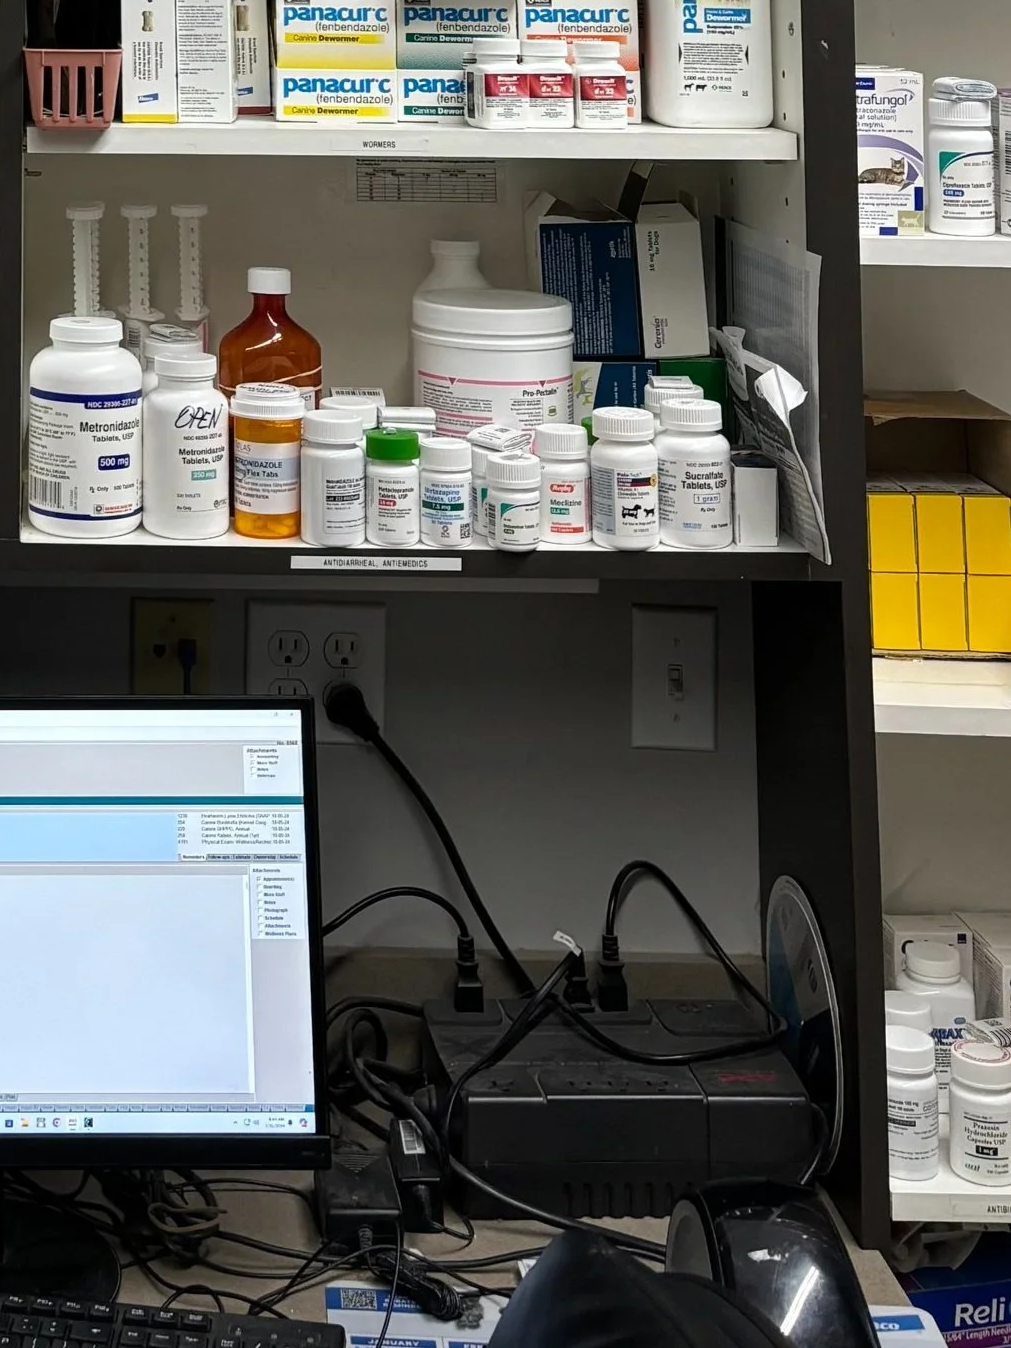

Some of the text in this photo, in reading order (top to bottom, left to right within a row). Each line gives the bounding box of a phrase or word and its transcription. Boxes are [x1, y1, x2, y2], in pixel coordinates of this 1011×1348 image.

[707, 14, 747, 23] Dewormer
[315, 22, 390, 34] (fenbendazole)
[436, 22, 510, 34] (fenbendazole)
[557, 23, 632, 34] (fenbendazole)
[293, 34, 359, 43] Canine Dewormer
[413, 34, 473, 42] Canine Deworm
[316, 95, 393, 105] (fenbendazole)
[317, 107, 358, 115] Dewormer
[654, 319, 662, 349] Cerenia
[174, 404, 223, 429] OPEN
[80, 419, 139, 432] Metronidazole
[179, 446, 225, 456] Metronidazole
[100, 457, 129, 467] 500 mg
[182, 455, 223, 465] Tablets, USP
[685, 472, 723, 480] Sucralfate
[681, 479, 727, 490] Tablets, USP
[550, 499, 582, 507] Meclizine
[323, 559, 428, 568] ANTIDIARRHEAL, ANTIEMEDICS
[973, 1122, 999, 1131] Prazosin
[967, 1136, 993, 1145] Capsules
[954, 1297, 1011, 1327] Reli
[967, 1330, 990, 1340] Length
